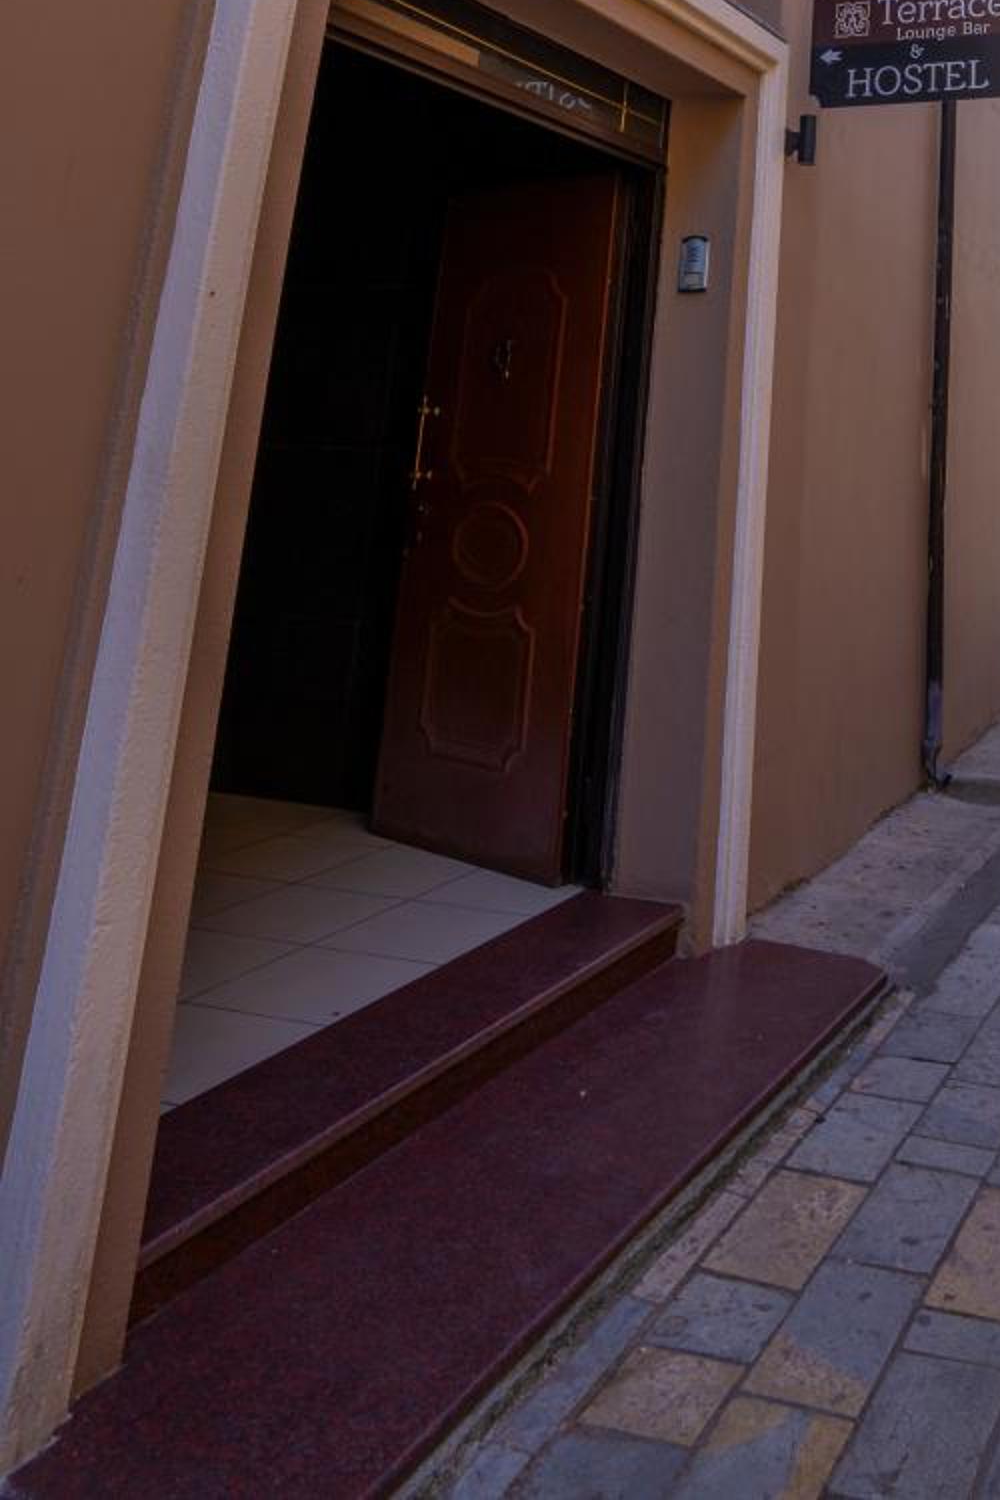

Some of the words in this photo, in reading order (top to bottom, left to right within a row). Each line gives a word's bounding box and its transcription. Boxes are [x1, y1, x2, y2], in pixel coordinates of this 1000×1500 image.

[896, 25, 956, 41] Lounge
[963, 21, 991, 36] Bar
[910, 43, 925, 58] &
[846, 59, 989, 98] HOSTEL
